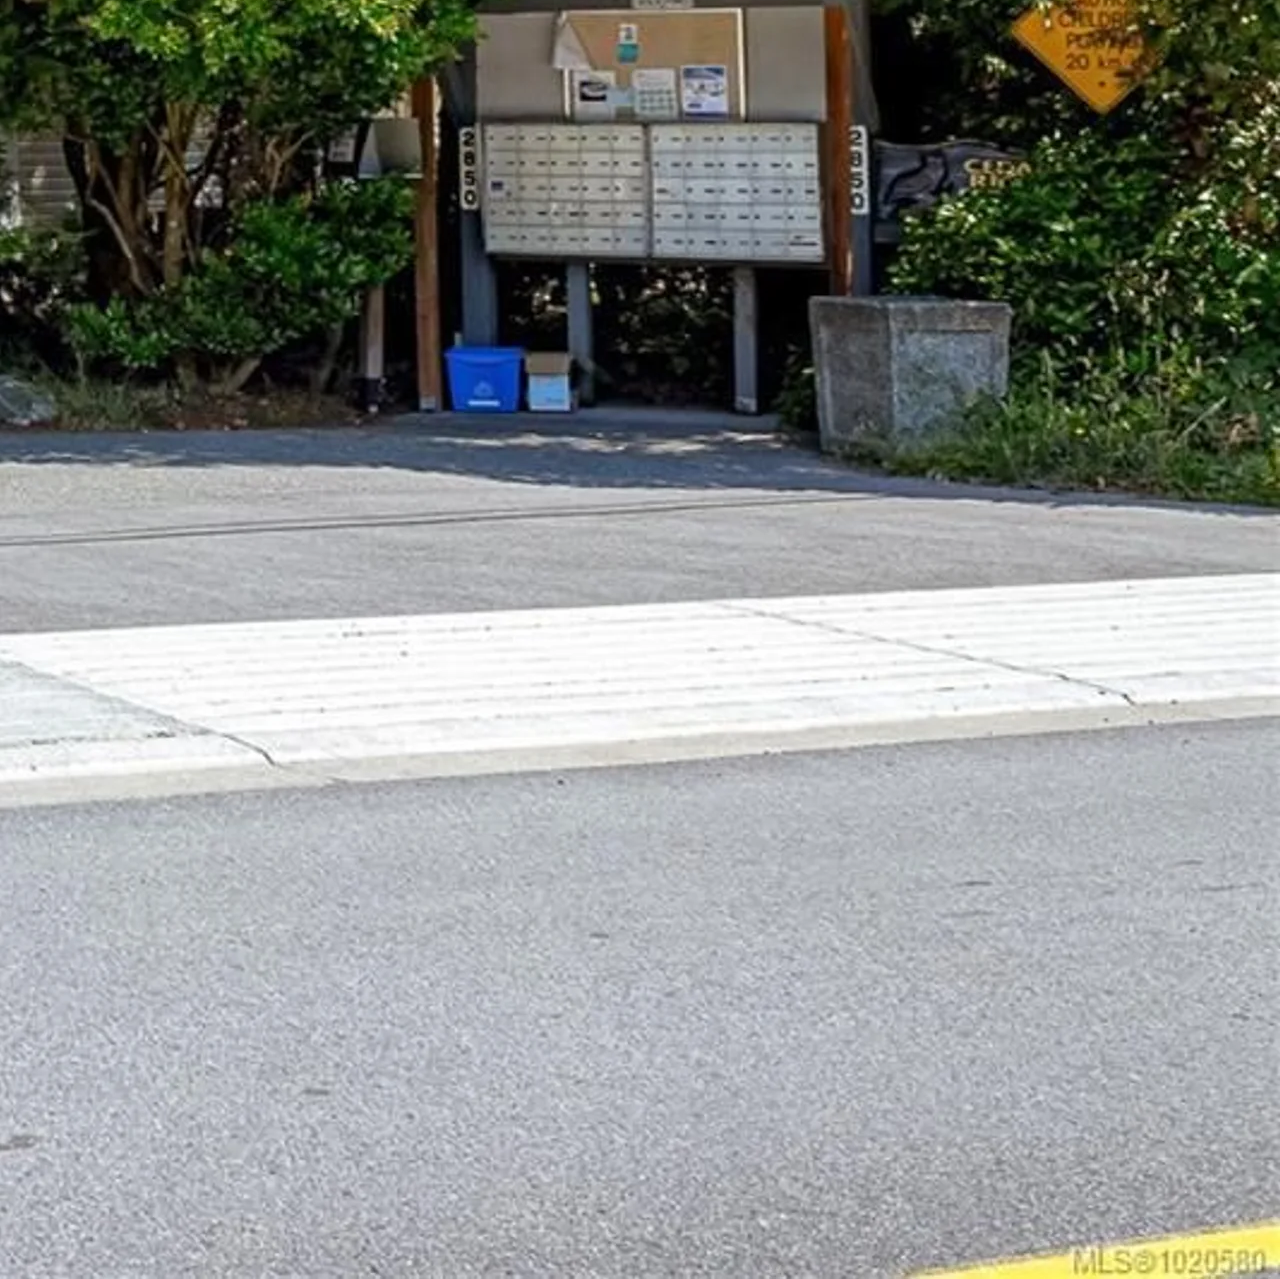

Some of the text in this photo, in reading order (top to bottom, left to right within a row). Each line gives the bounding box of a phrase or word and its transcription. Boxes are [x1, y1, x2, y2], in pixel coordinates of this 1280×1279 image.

[1066, 53, 1090, 71] 20
[462, 130, 477, 207] 2850
[849, 129, 864, 209] 2850
